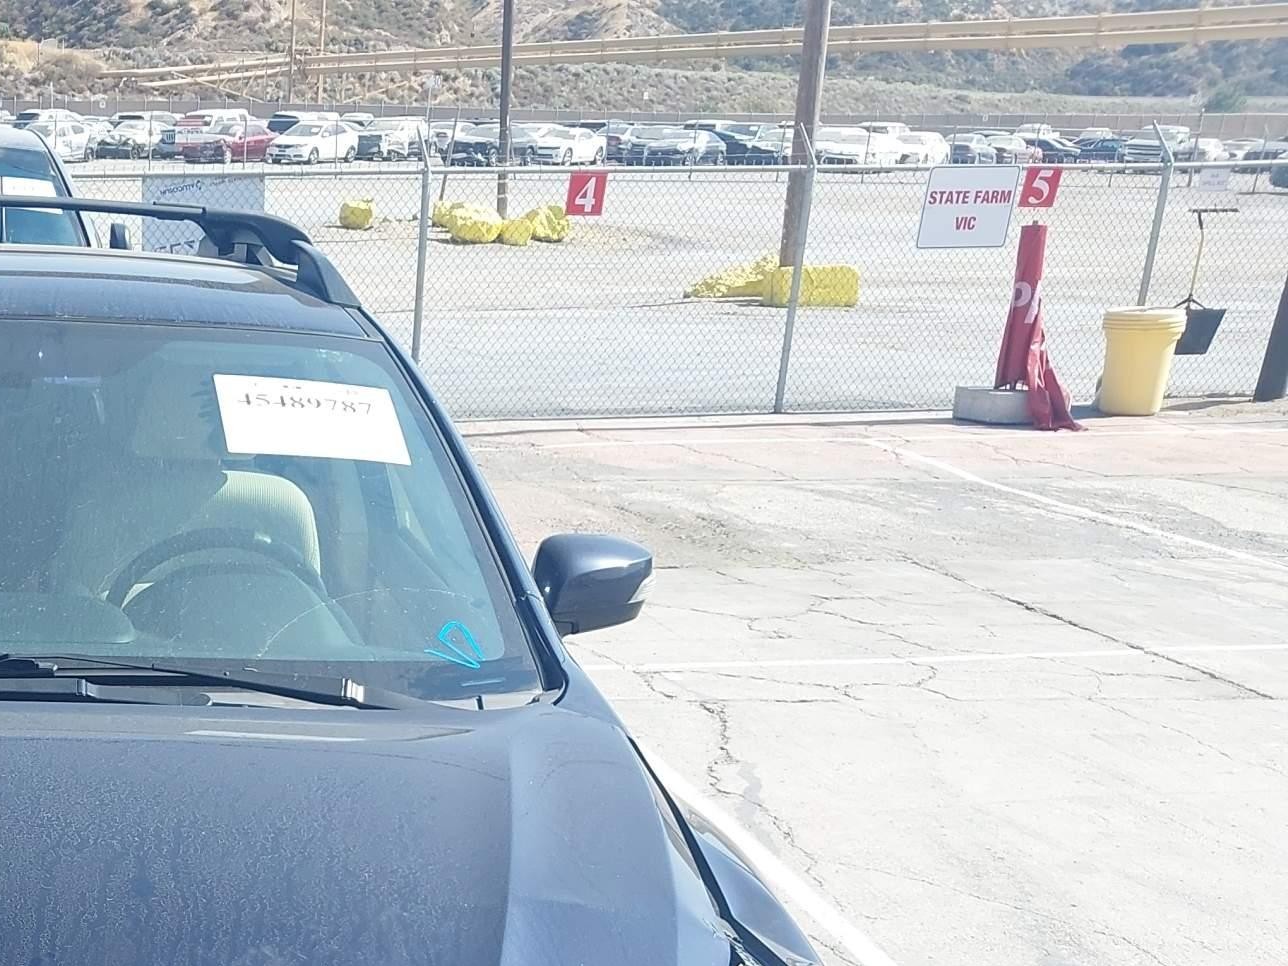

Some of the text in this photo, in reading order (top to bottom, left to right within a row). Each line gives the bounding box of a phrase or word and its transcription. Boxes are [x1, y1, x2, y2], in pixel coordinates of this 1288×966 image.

[574, 177, 597, 212] 4
[928, 189, 1013, 205] STATE FARM
[1028, 169, 1054, 204] 5
[955, 215, 977, 230] VIC
